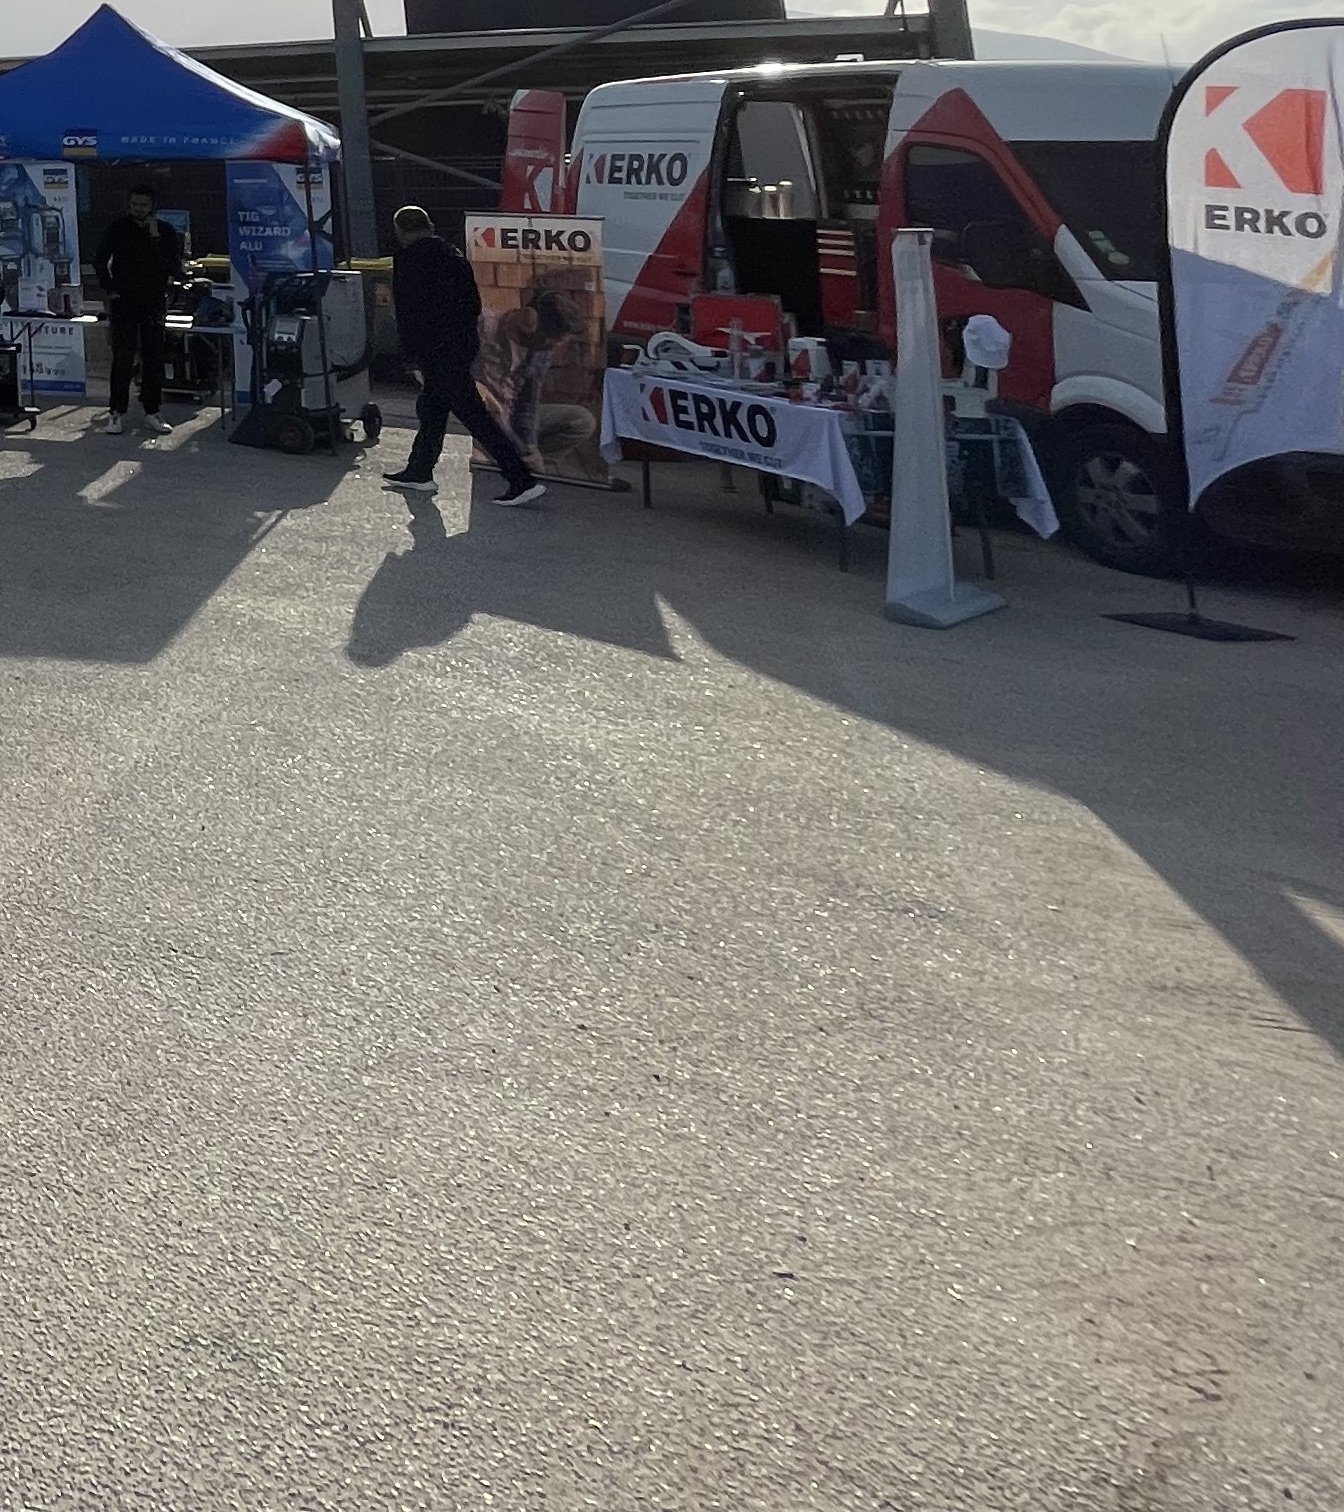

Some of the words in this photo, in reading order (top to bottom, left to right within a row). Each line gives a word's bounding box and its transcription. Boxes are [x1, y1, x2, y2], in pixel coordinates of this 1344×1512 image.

[62, 135, 98, 146] GYS
[607, 152, 689, 187] ERKO
[237, 211, 260, 222] TIG
[1204, 203, 1328, 239] ERKO
[238, 225, 292, 237] WIZARD
[500, 227, 591, 253] ERKO
[239, 240, 263, 252] ALU
[668, 388, 778, 448] ERKO
